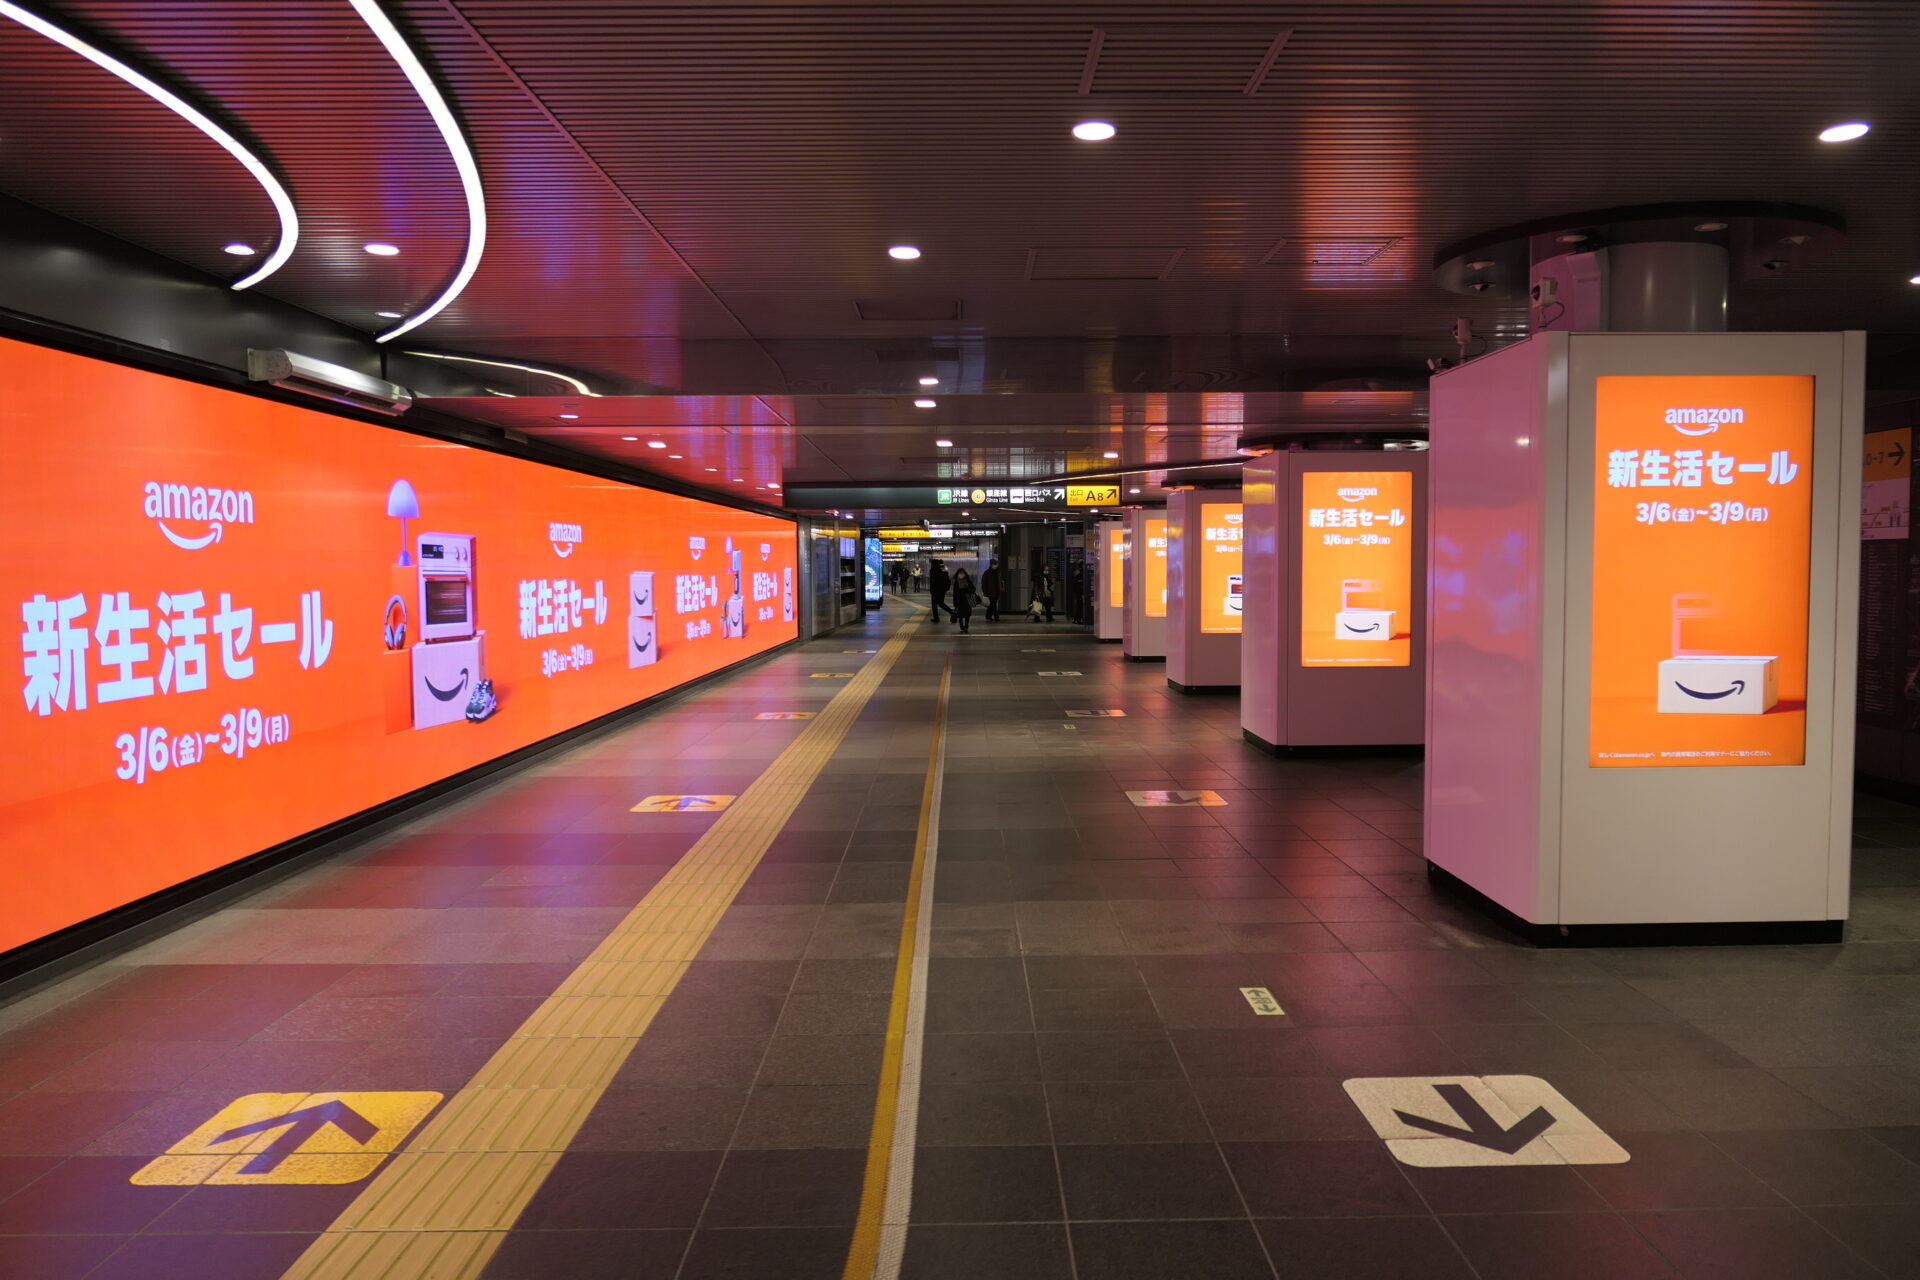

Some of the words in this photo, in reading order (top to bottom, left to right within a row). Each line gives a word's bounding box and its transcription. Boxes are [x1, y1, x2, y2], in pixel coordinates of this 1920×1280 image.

[1664, 408, 1744, 424] amazon
[1607, 449, 1798, 488] 新生活セール
[143, 481, 254, 524] amazon
[1070, 489, 1084, 497] 出口
[1337, 487, 1377, 497] amazon
[1309, 508, 1405, 528] 新生活セール
[550, 522, 583, 543] amazon
[519, 578, 608, 639] 新生活セール
[22, 589, 334, 717] 新生活セール
